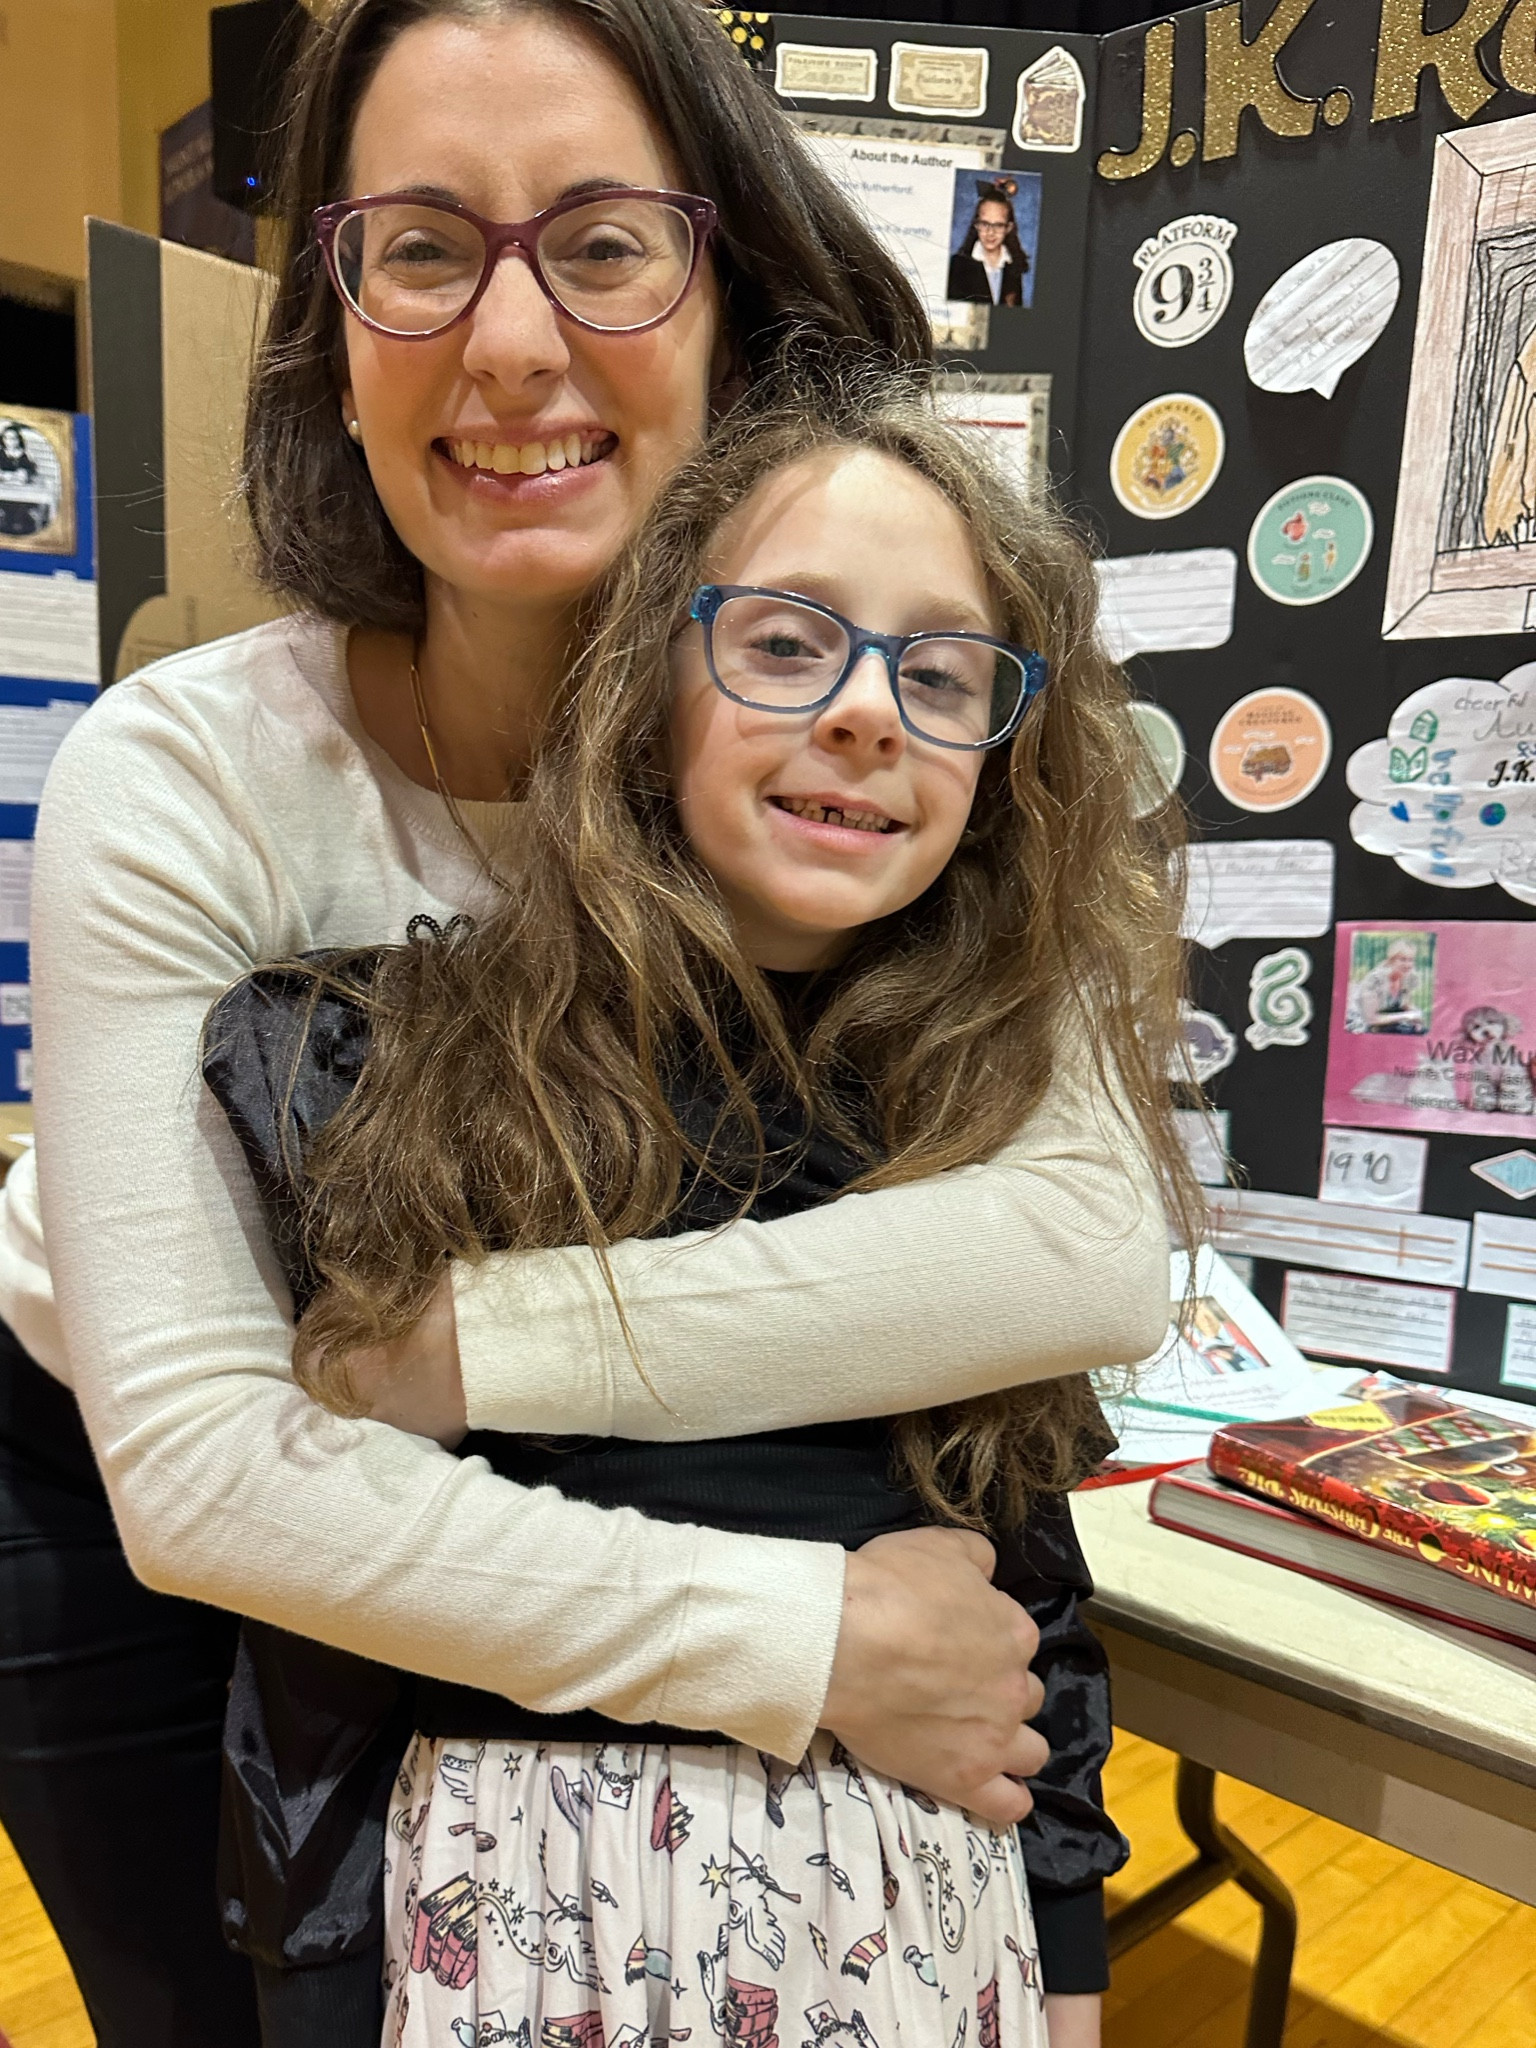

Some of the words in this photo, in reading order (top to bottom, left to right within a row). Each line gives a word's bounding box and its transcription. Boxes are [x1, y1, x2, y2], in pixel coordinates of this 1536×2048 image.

[851, 149, 888, 162] About
[890, 152, 910, 164] the
[911, 155, 953, 167] Author
[1137, 221, 1232, 266] PLATFORM
[1426, 1039, 1487, 1064] Wax
